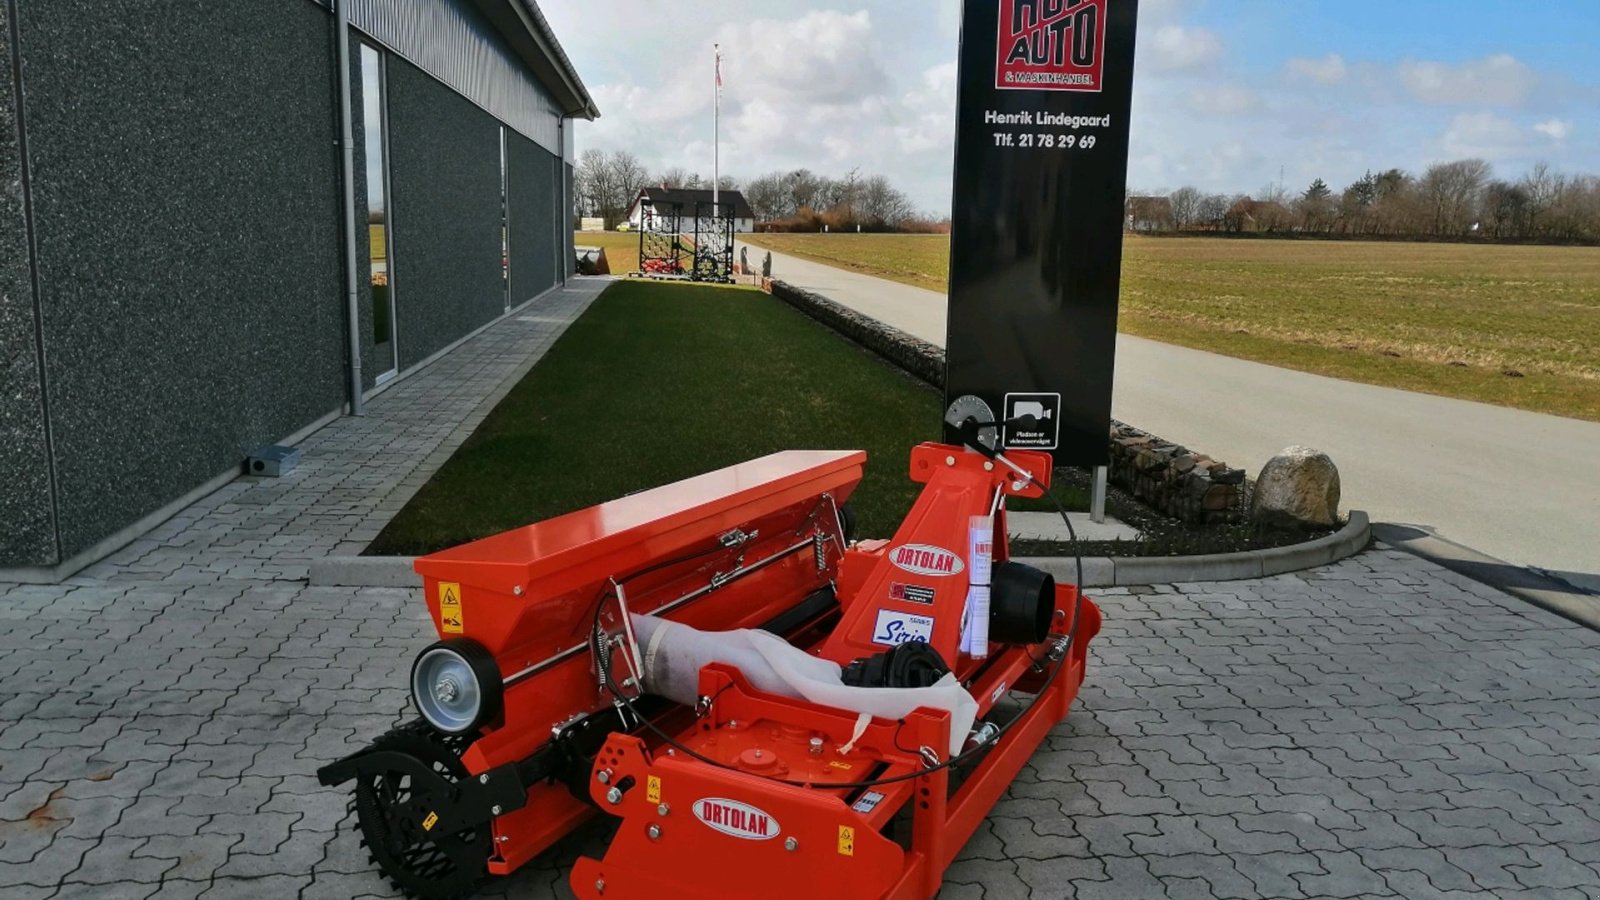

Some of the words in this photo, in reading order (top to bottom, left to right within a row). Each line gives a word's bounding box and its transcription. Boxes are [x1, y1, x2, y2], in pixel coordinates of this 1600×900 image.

[1005, 3, 1097, 67] AUTO
[1005, 71, 1014, 82] &
[1015, 72, 1094, 85] MASKINHANDEL
[984, 110, 1032, 125] Henrik
[1036, 111, 1110, 128] Lindegaard
[993, 133, 1015, 147] Tlf.
[1019, 134, 1033, 147] 21
[1037, 134, 1054, 148] 78
[1058, 135, 1075, 148] 29
[1079, 135, 1096, 149] 69
[896, 547, 955, 572] ORTOLAN
[702, 801, 768, 836] ORTOLAN
